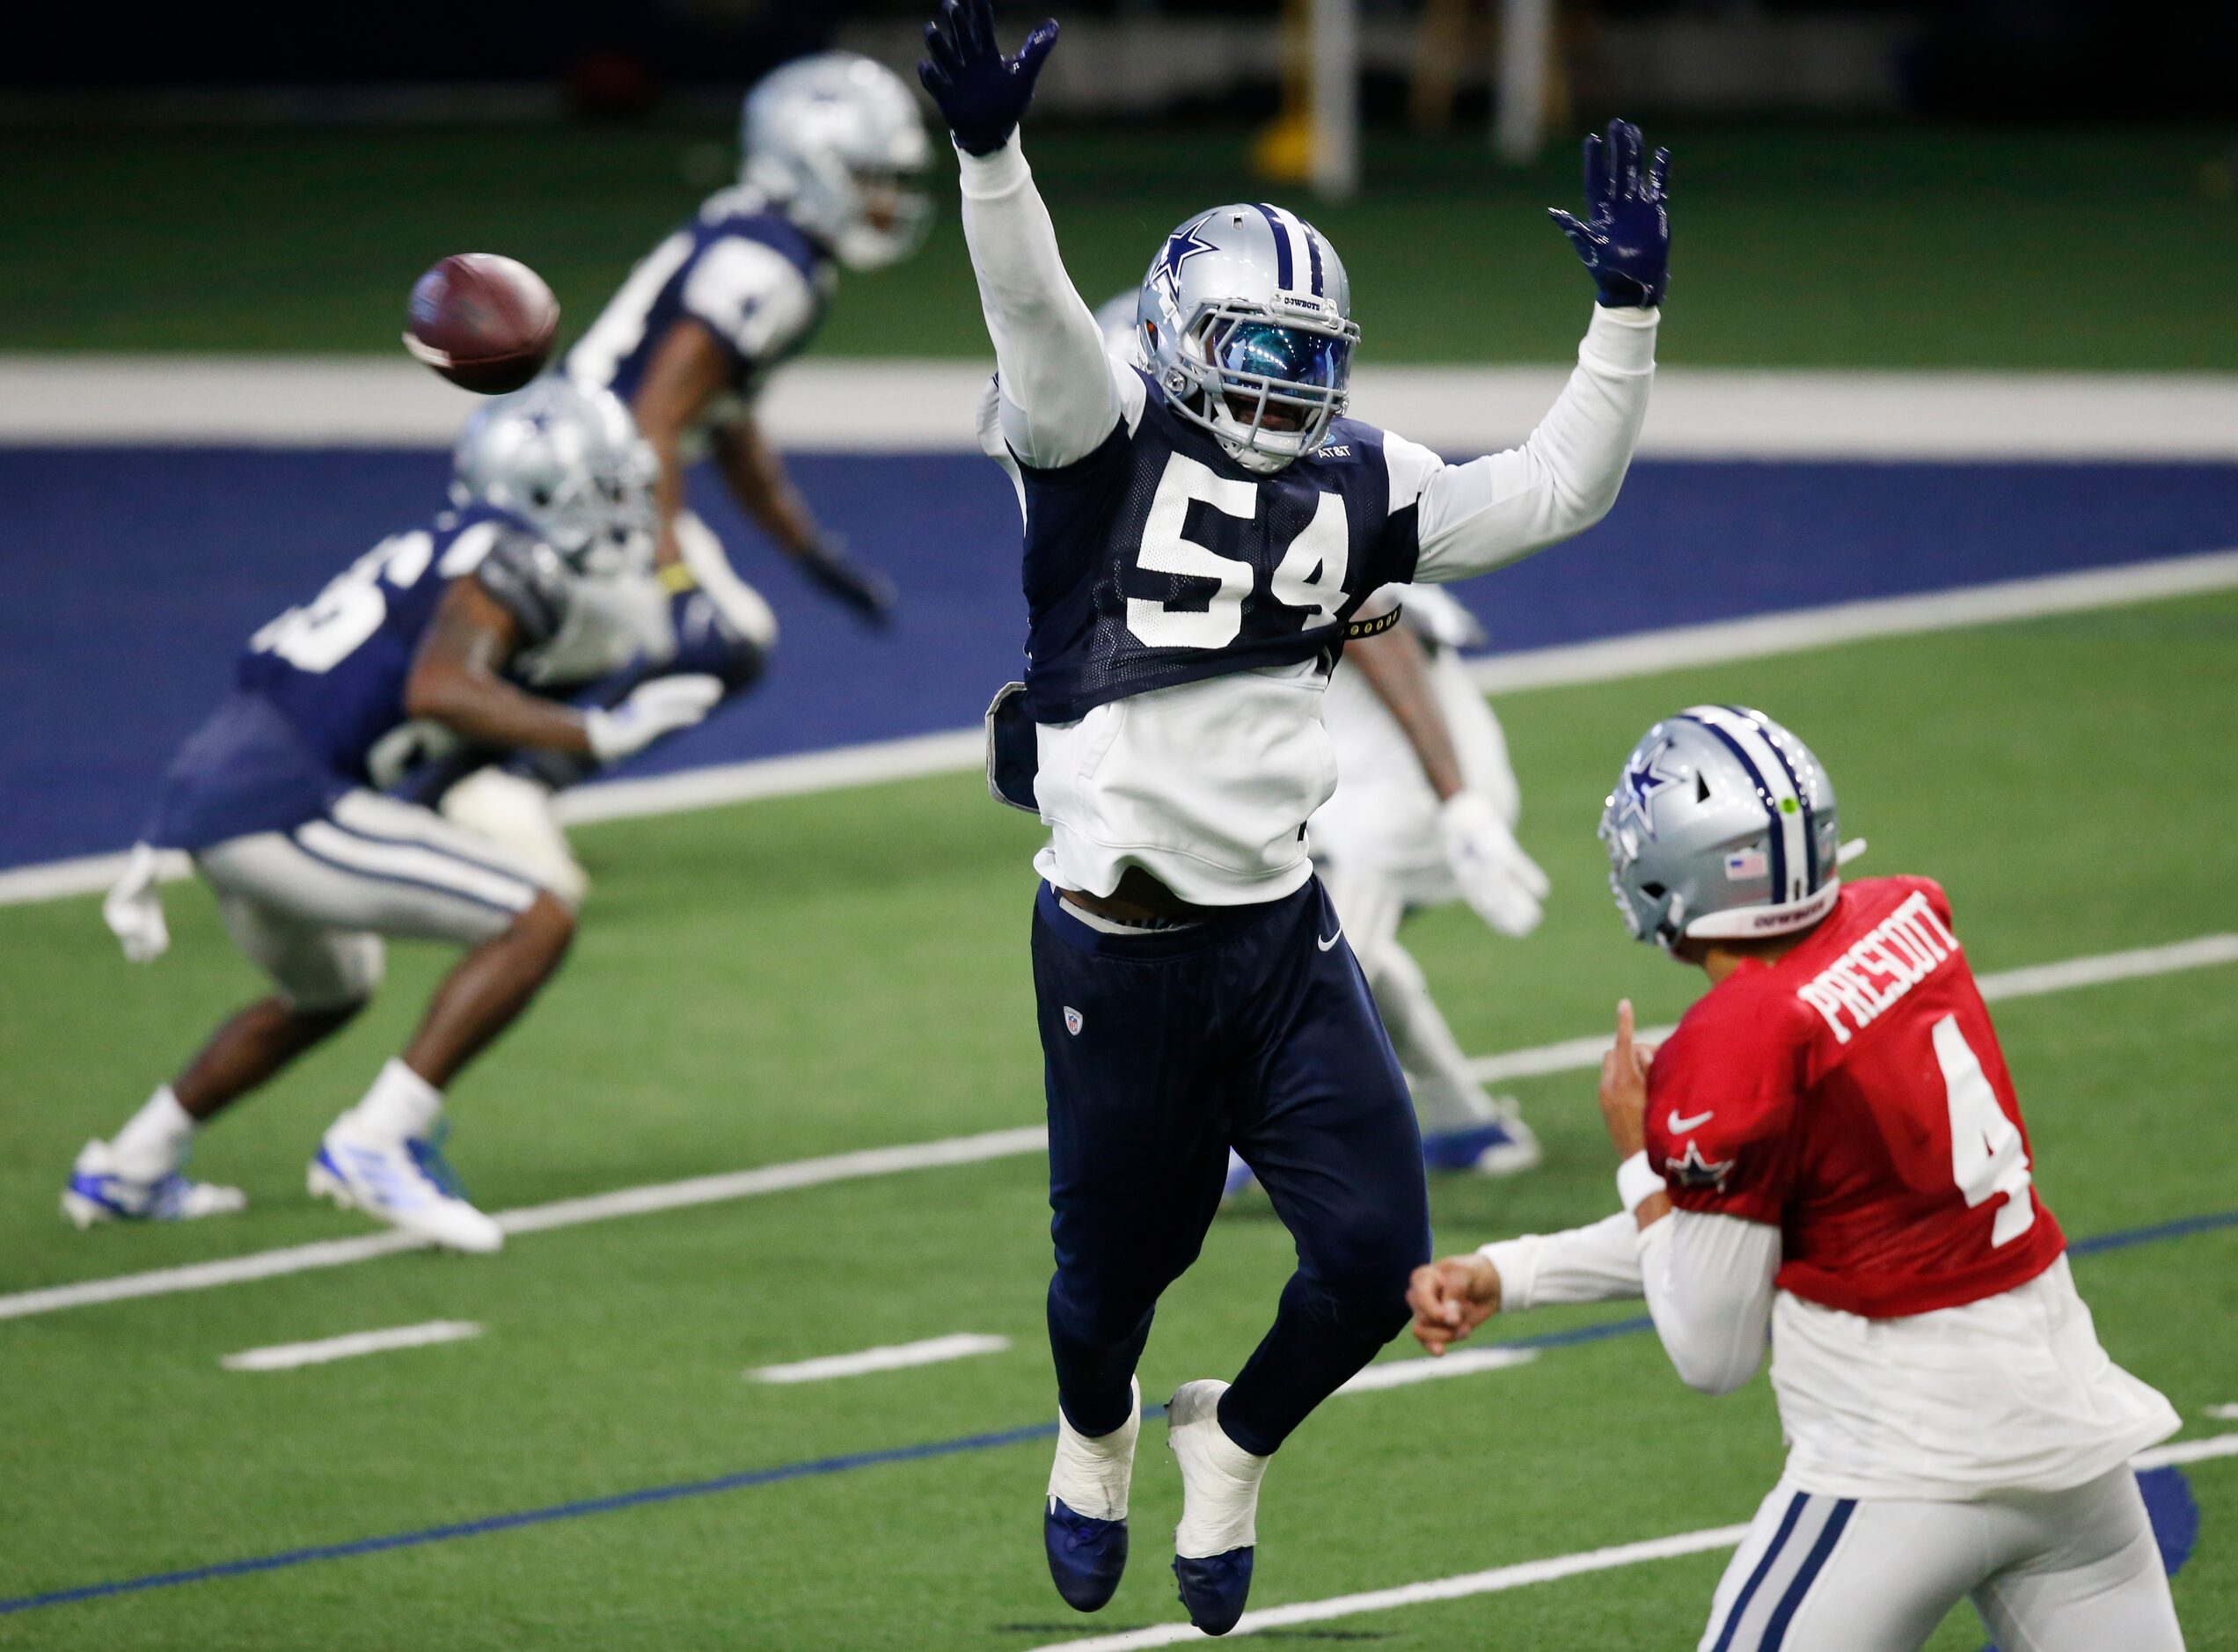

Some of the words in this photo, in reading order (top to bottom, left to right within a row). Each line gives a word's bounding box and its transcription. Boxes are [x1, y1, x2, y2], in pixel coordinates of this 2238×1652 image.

[1284, 297, 1320, 311] COWBOYS
[1317, 445, 1351, 459] AT&T
[1126, 450, 1350, 650] 54
[1796, 889, 1960, 1045] PRESCOTT
[1932, 1013, 2036, 1249] 4
